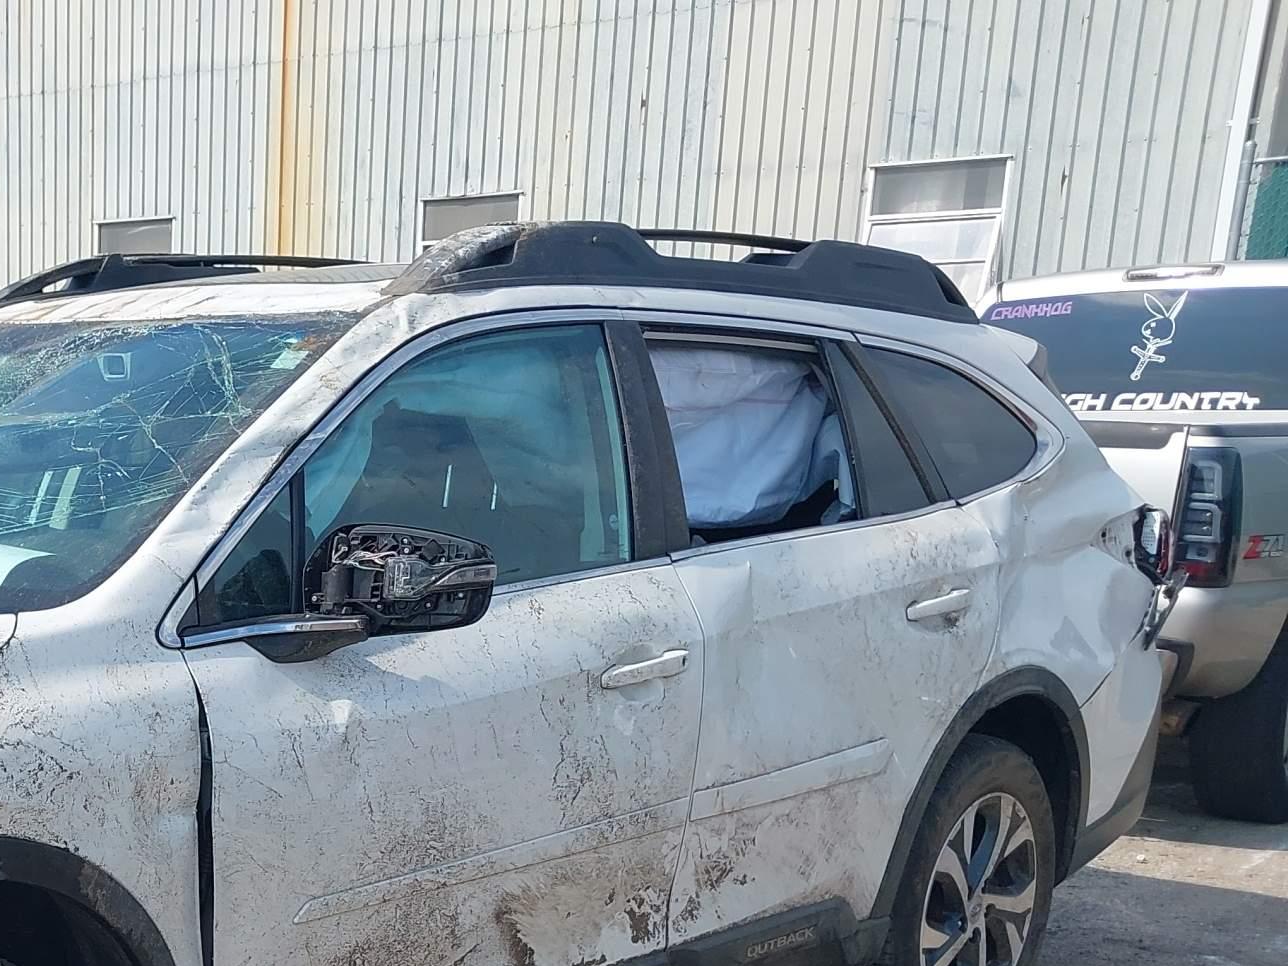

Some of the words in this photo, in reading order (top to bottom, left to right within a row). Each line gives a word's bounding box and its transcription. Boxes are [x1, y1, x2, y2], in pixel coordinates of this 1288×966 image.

[991, 301, 1072, 320] CRANKHOG
[1061, 393, 1106, 411] GH
[1112, 391, 1260, 411] COUNTRY
[1243, 534, 1282, 560] Z71
[747, 926, 816, 958] OUTBACK
